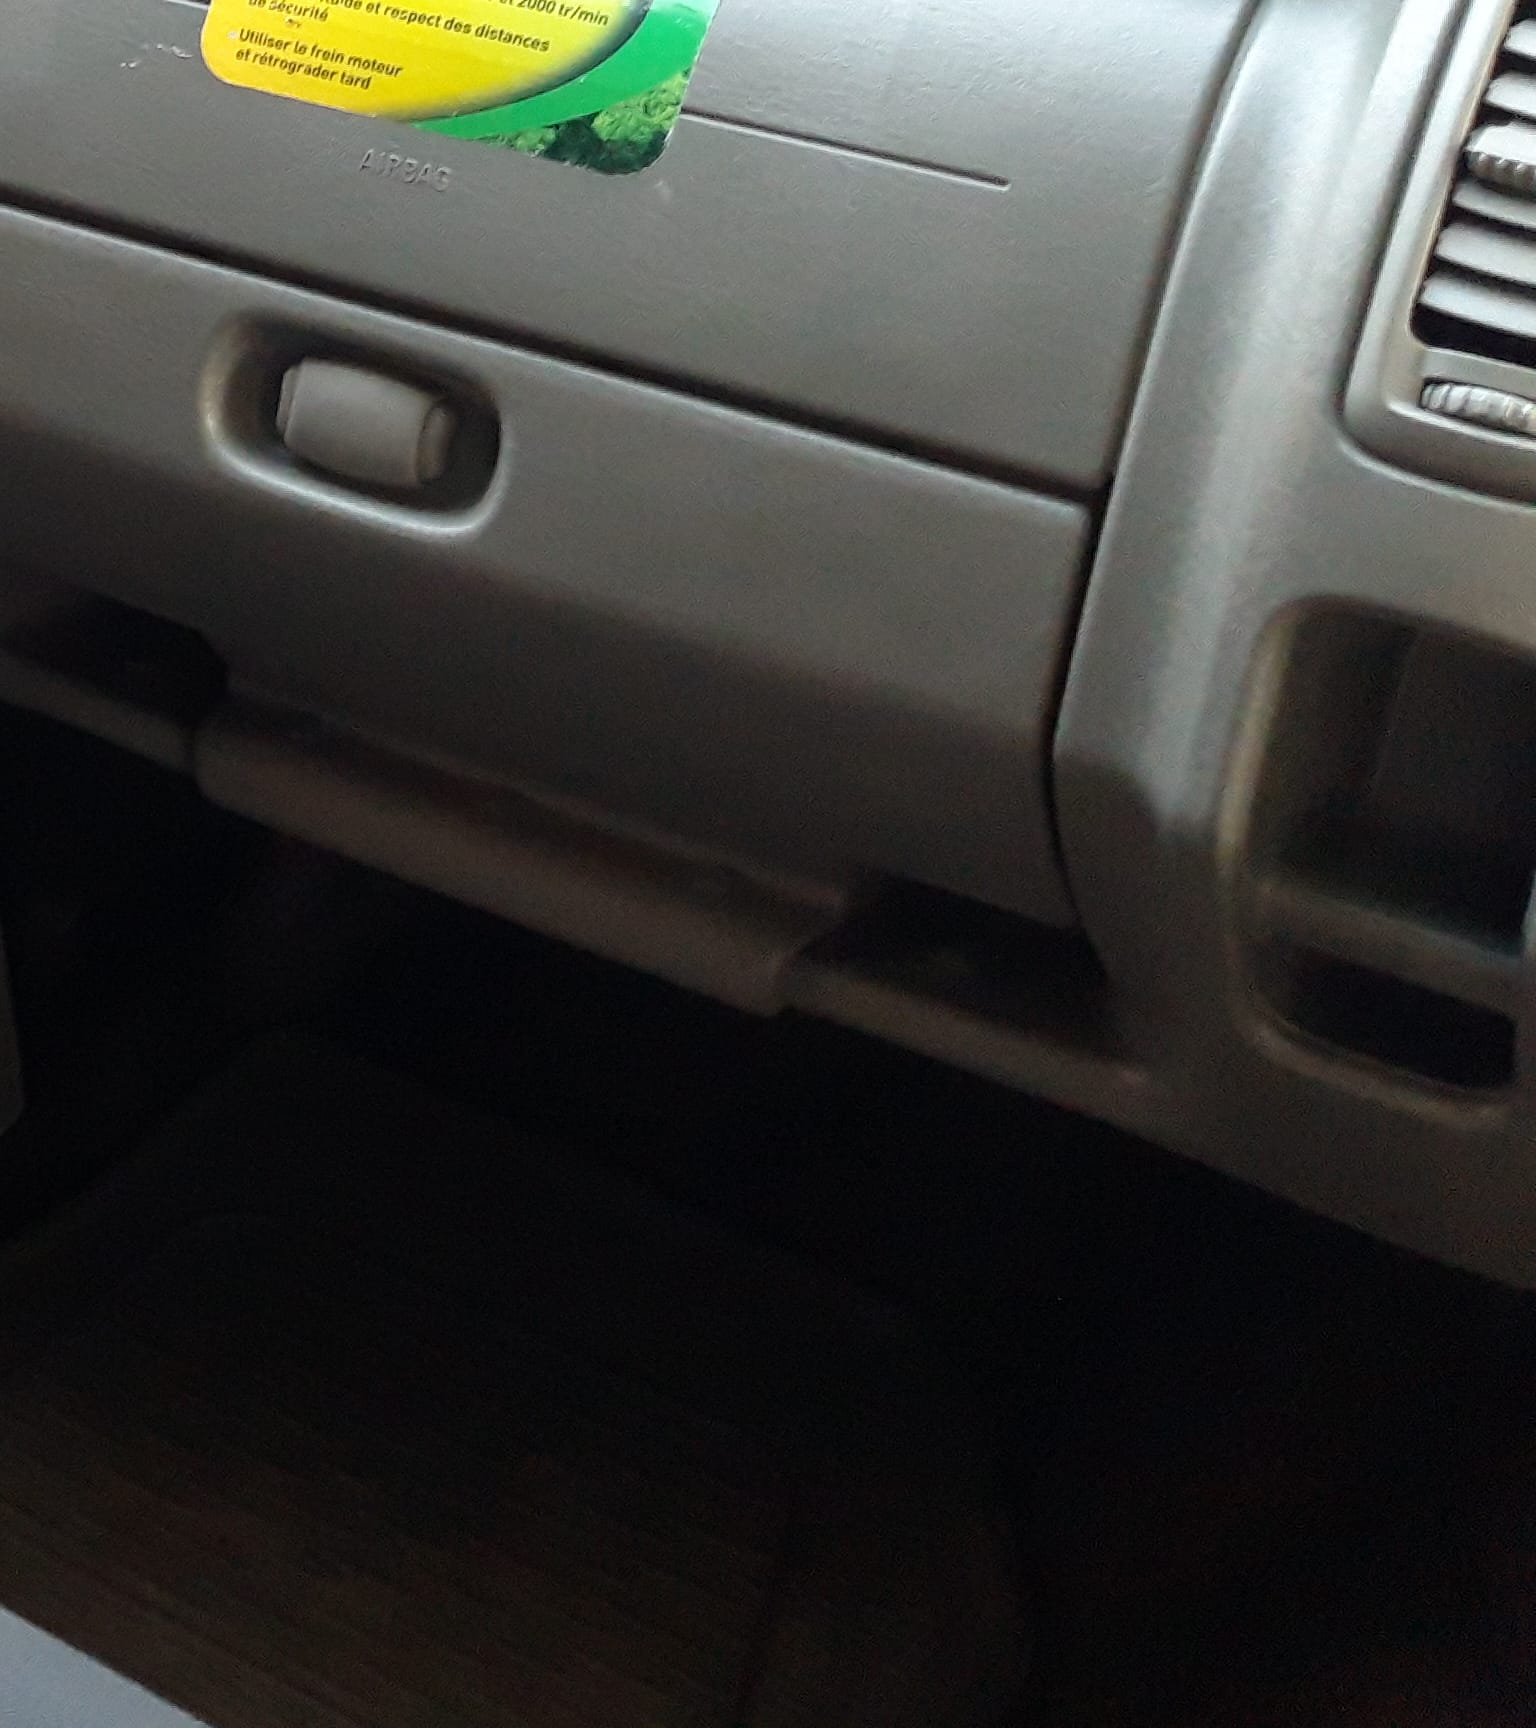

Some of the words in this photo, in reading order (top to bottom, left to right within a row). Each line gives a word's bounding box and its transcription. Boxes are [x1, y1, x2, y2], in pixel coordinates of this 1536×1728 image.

[365, 0, 381, 14] et
[383, 4, 442, 29] respect
[442, 17, 473, 33] des
[474, 22, 551, 52] distances
[558, 3, 610, 26] tr/min
[235, 48, 252, 62] et
[252, 49, 337, 81] rétrograder
[339, 72, 372, 90] tard
[239, 28, 292, 51] Utiliser
[293, 39, 308, 55] le
[310, 42, 346, 66] frein
[346, 54, 404, 78] moteur
[358, 148, 452, 192] AIRBAG
